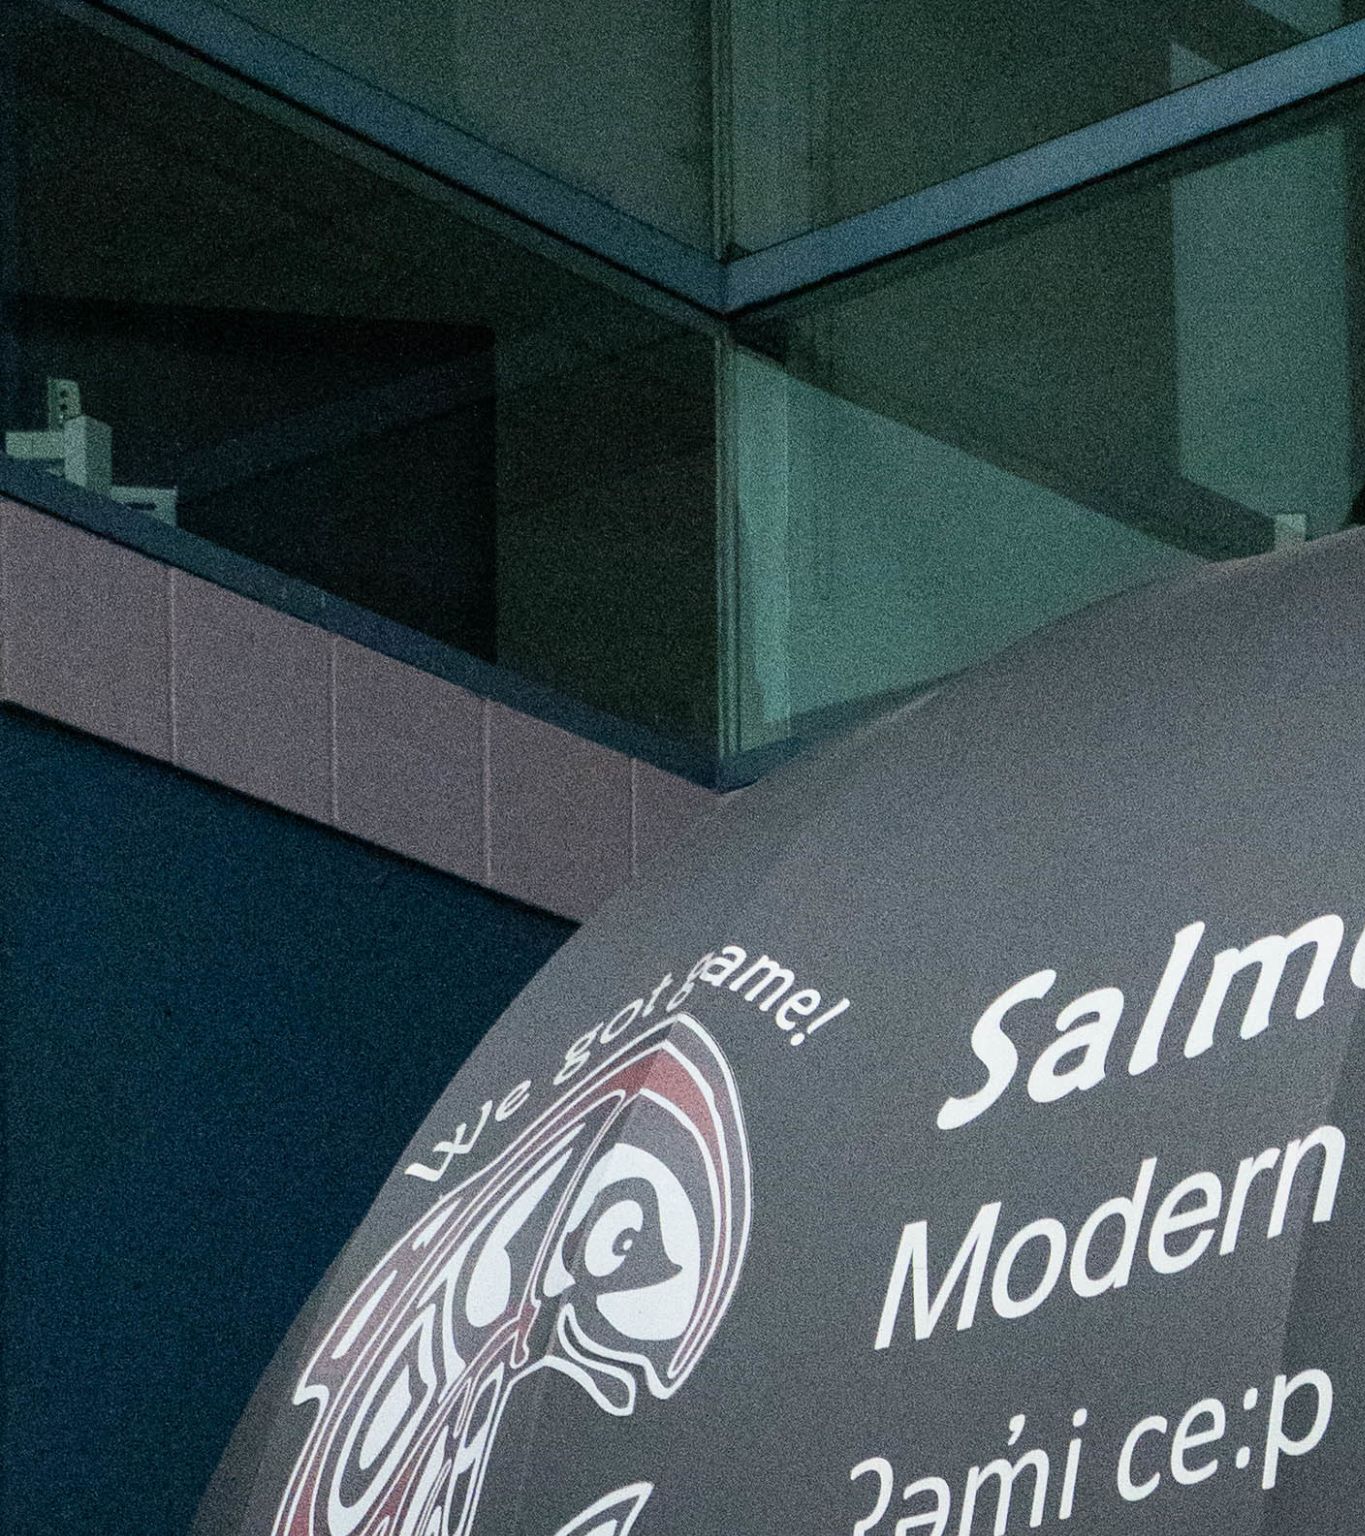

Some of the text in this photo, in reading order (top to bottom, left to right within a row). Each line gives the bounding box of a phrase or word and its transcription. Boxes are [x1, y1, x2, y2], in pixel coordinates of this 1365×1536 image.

[405, 945, 851, 1181] We got game!
[873, 1123, 1346, 1351] Modern
